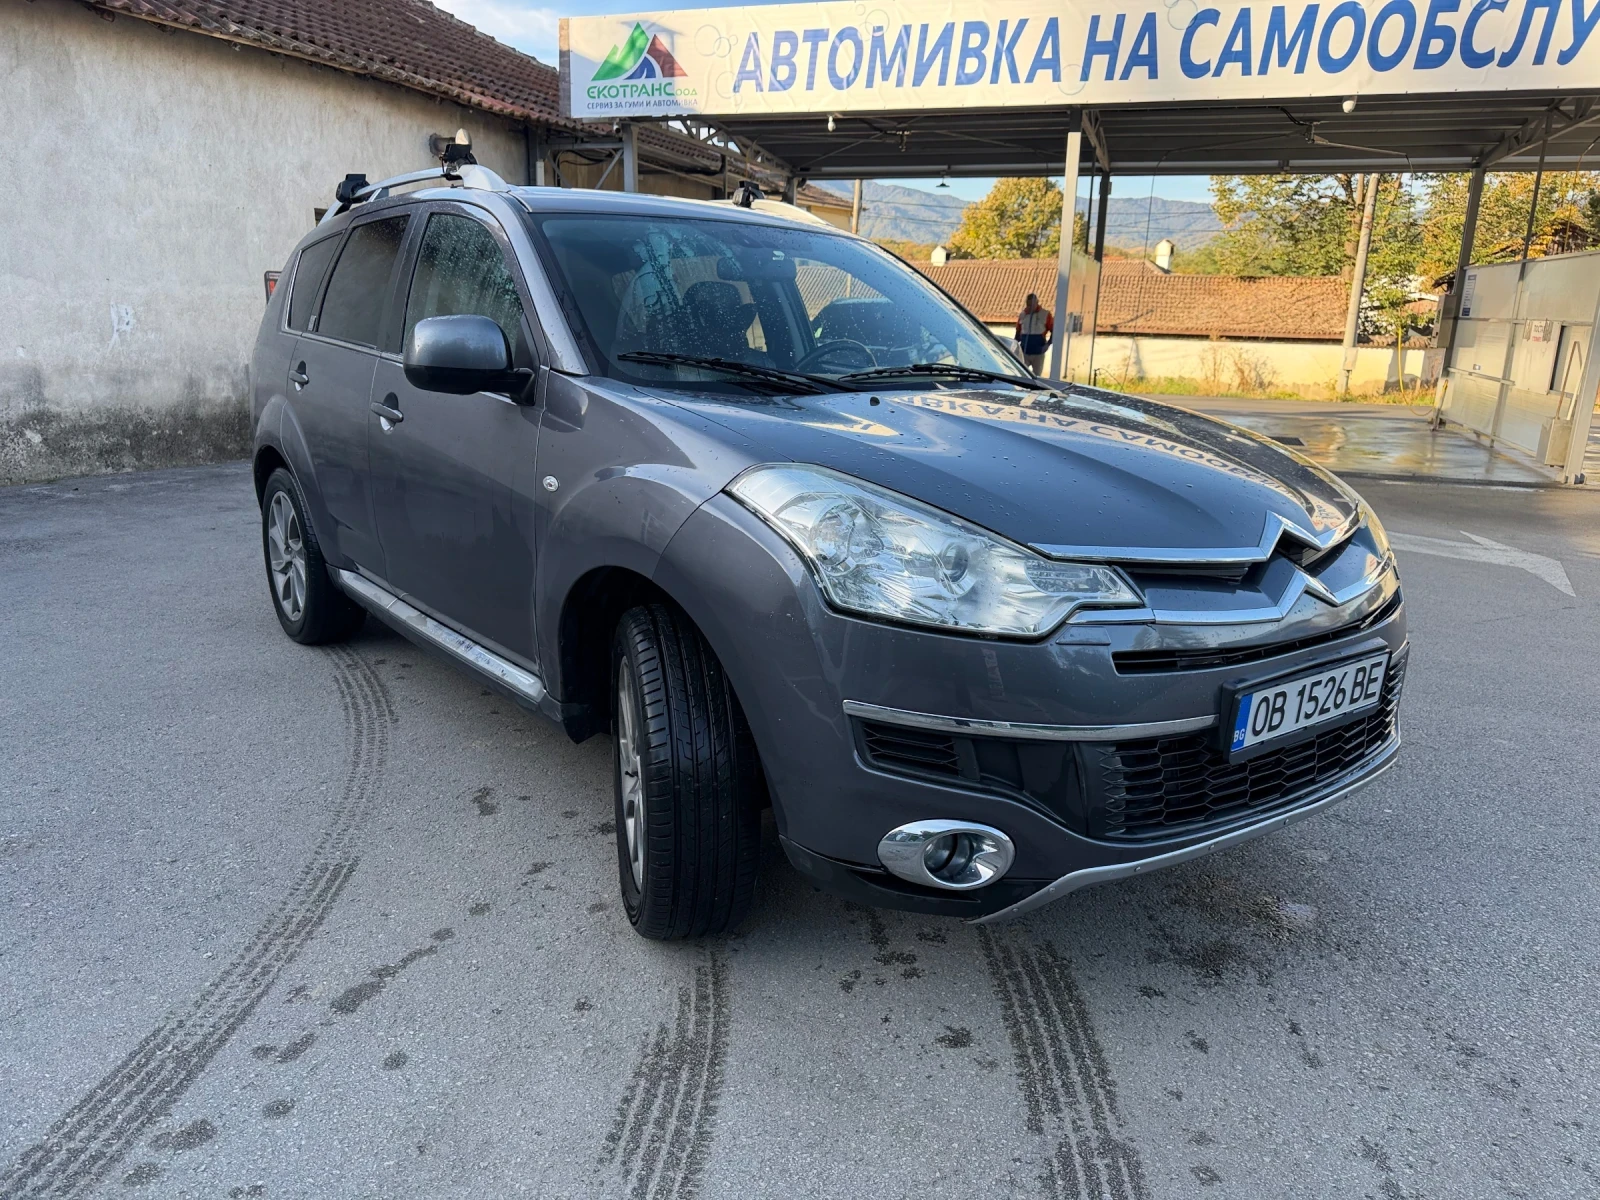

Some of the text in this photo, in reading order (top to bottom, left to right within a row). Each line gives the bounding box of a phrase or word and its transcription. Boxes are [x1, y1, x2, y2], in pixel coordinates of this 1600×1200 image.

[733, 0, 1600, 93] АВТОМИВКА НА САМООБСЛУ
[587, 101, 613, 110] СЕРВИЗ
[615, 101, 624, 109] ЗА
[1252, 660, 1383, 737] OB 1526 BE
[1233, 728, 1246, 743] BG
